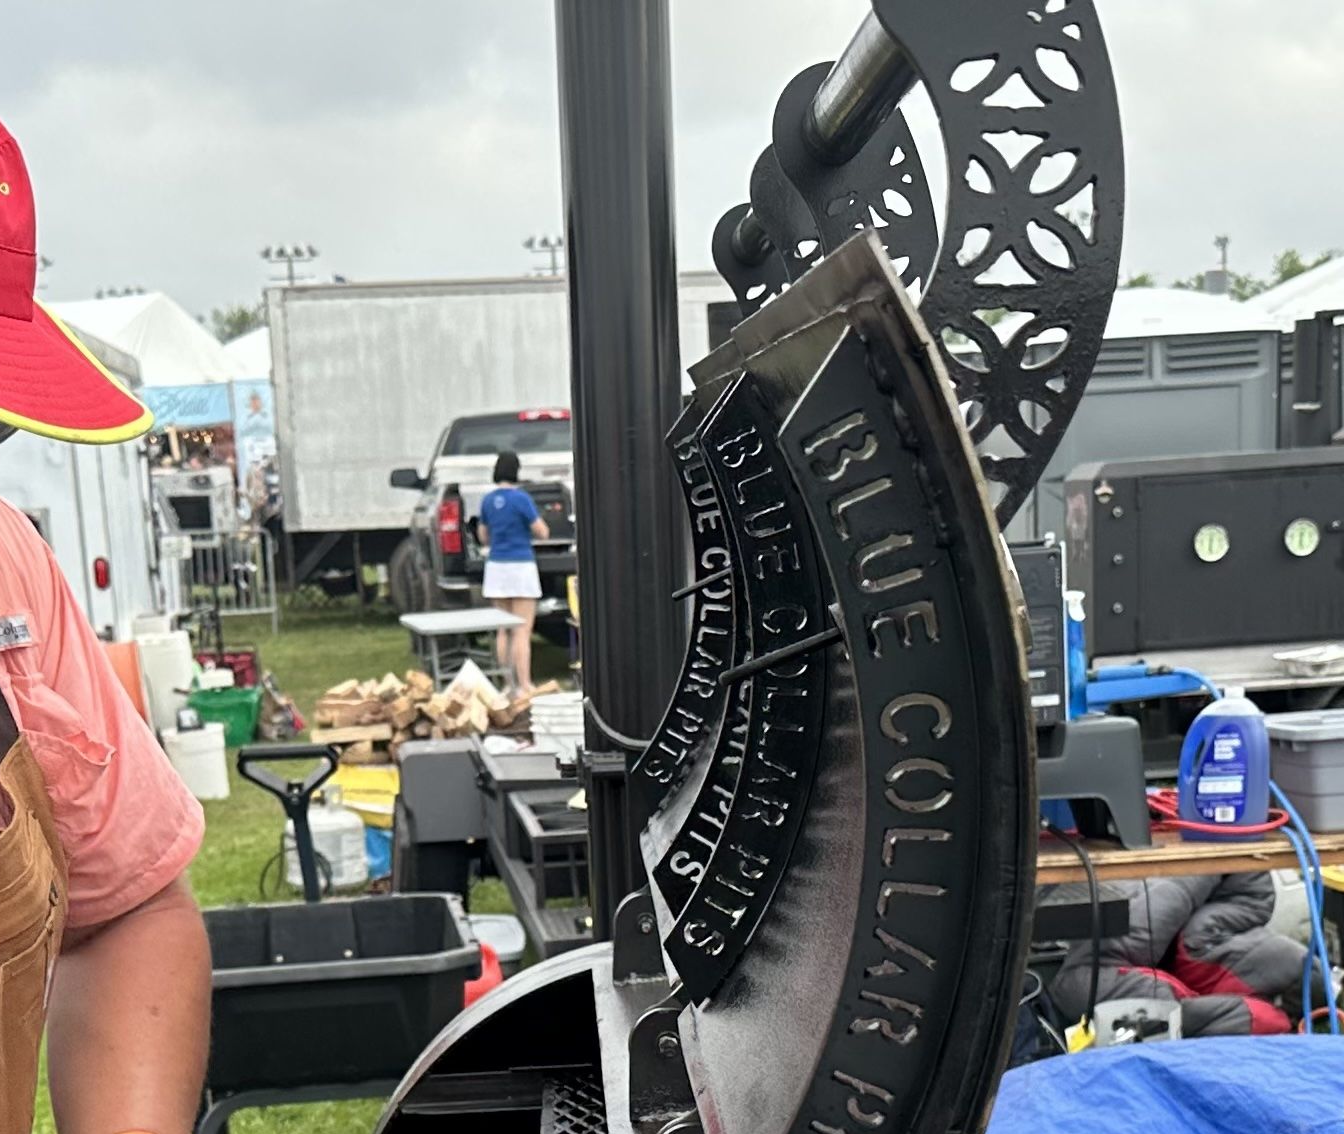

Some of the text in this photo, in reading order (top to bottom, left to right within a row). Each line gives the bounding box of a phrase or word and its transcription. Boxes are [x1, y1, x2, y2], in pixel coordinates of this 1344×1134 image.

[674, 434, 721, 534] BLUE
[717, 426, 801, 580] BLUE
[801, 410, 941, 658] BLUE
[684, 547, 731, 699] COLLAR
[644, 706, 703, 783] PITS
[742, 605, 808, 827] COLLAR
[683, 844, 770, 956] PITS
[849, 692, 954, 1045] COLLAR
